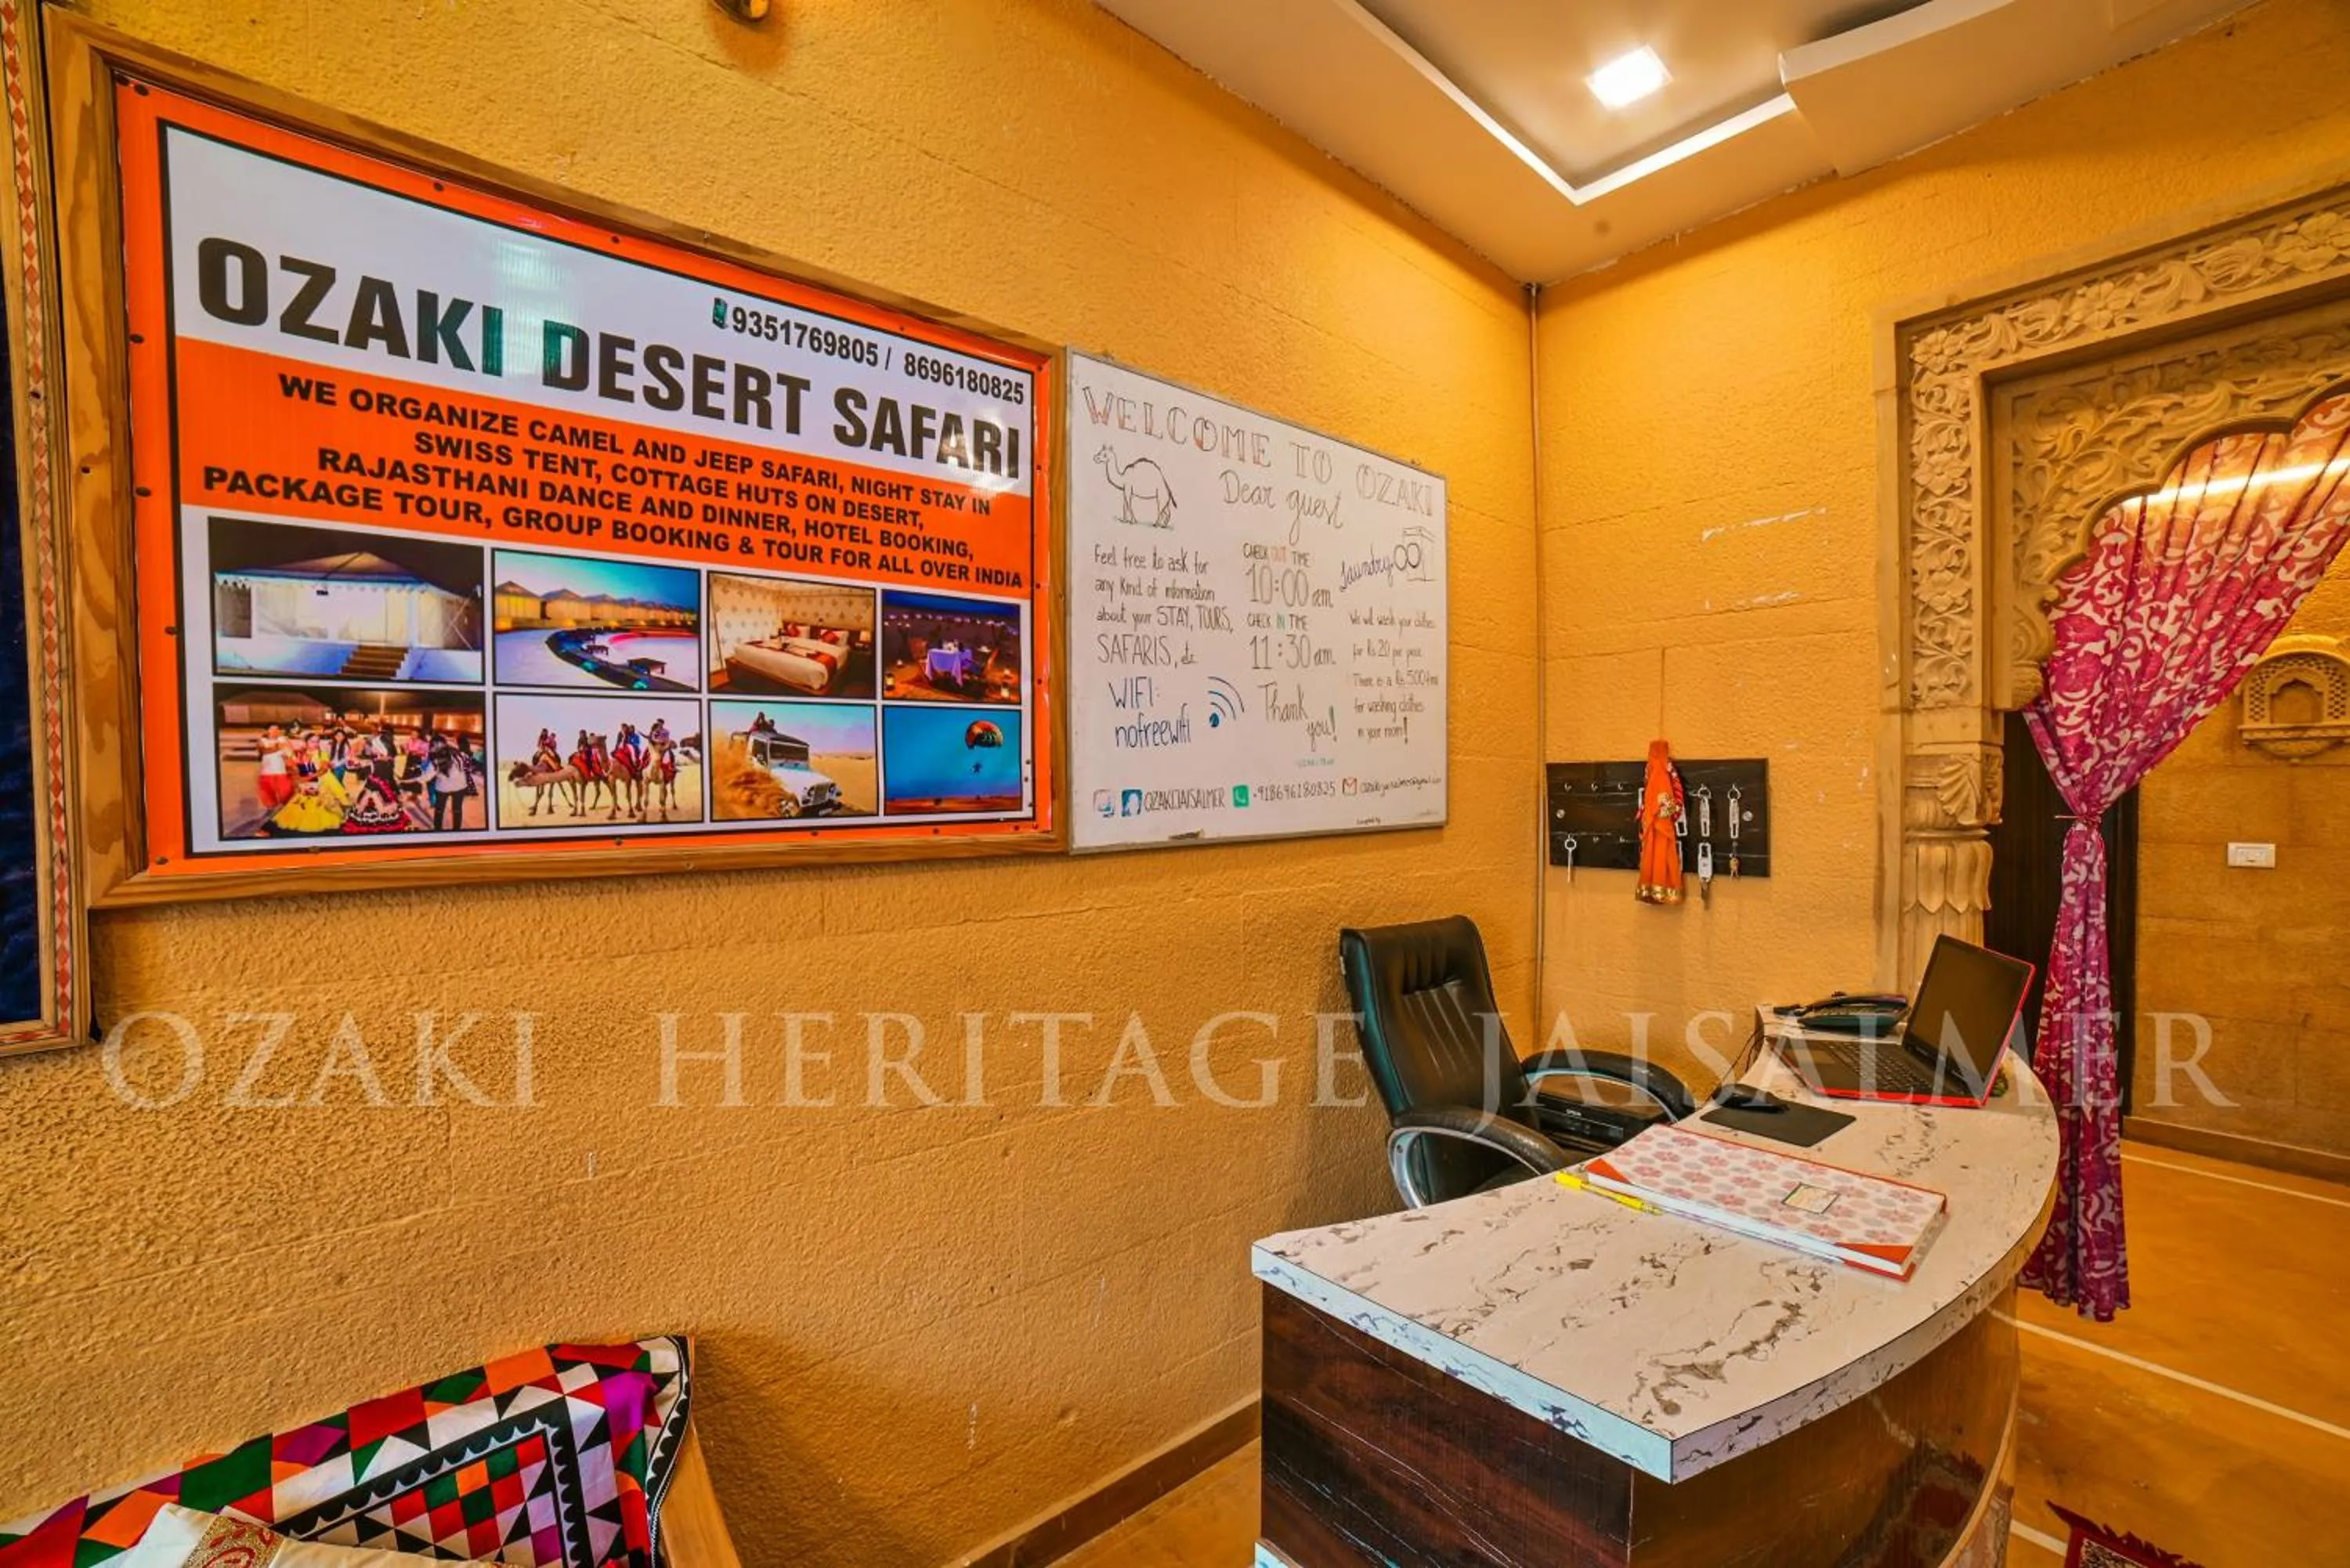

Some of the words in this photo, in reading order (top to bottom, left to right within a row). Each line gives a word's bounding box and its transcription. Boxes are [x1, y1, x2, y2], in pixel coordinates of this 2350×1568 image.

[198, 237, 504, 378] OZAKI
[542, 320, 811, 435] DESERT
[833, 388, 1020, 479] SAFARI
[732, 306, 878, 367] 9351769805
[904, 352, 1024, 405] 8696180825
[279, 374, 336, 406] WE
[349, 388, 518, 436] ORGANIZE
[529, 420, 624, 454] CAMEL
[633, 439, 686, 464] AND
[694, 450, 754, 473] JEEP
[761, 461, 844, 493] SAFARI,
[851, 476, 913, 502] NIGHT
[920, 489, 964, 511] STAY
[972, 498, 990, 515] IN
[415, 432, 512, 466] SWISS
[523, 449, 602, 483] TENT,
[611, 463, 728, 498] COTTAGE
[736, 483, 797, 508] HUTS
[806, 494, 836, 515] ON
[844, 500, 924, 530] DESERT,
[1083, 386, 1271, 468] WELCOME
[1292, 444, 1332, 484] TO
[1356, 464, 1434, 516] OZAKI
[204, 465, 382, 511] PACKAGE
[394, 492, 491, 529] TOUR,
[503, 508, 602, 537] GROUP
[612, 519, 729, 552] BOOKING
[739, 536, 754, 555] &
[763, 540, 823, 563] TOUR
[830, 548, 871, 569] FOR
[878, 555, 913, 574] ALL
[920, 561, 969, 581] OVER
[975, 569, 1022, 588] INDIA
[319, 447, 527, 499] RAJASTHANI
[539, 481, 631, 512] DANCE
[642, 497, 693, 520] AND
[703, 504, 797, 537] DINNER,
[804, 520, 873, 545] HOTEL
[880, 530, 974, 560] BOOKING,
[1220, 470, 1276, 508] Dear
[1286, 489, 1343, 546] guest
[1095, 544, 1117, 565] Feel
[1123, 546, 1146, 569] free
[1152, 545, 1163, 569] to
[1167, 547, 1188, 573] ask
[1095, 579, 1114, 602] any
[1246, 563, 1309, 608] 10:00
[1097, 602, 1126, 623] about
[1249, 634, 1311, 670] 11:30
[1257, 681, 1308, 722] Thank
